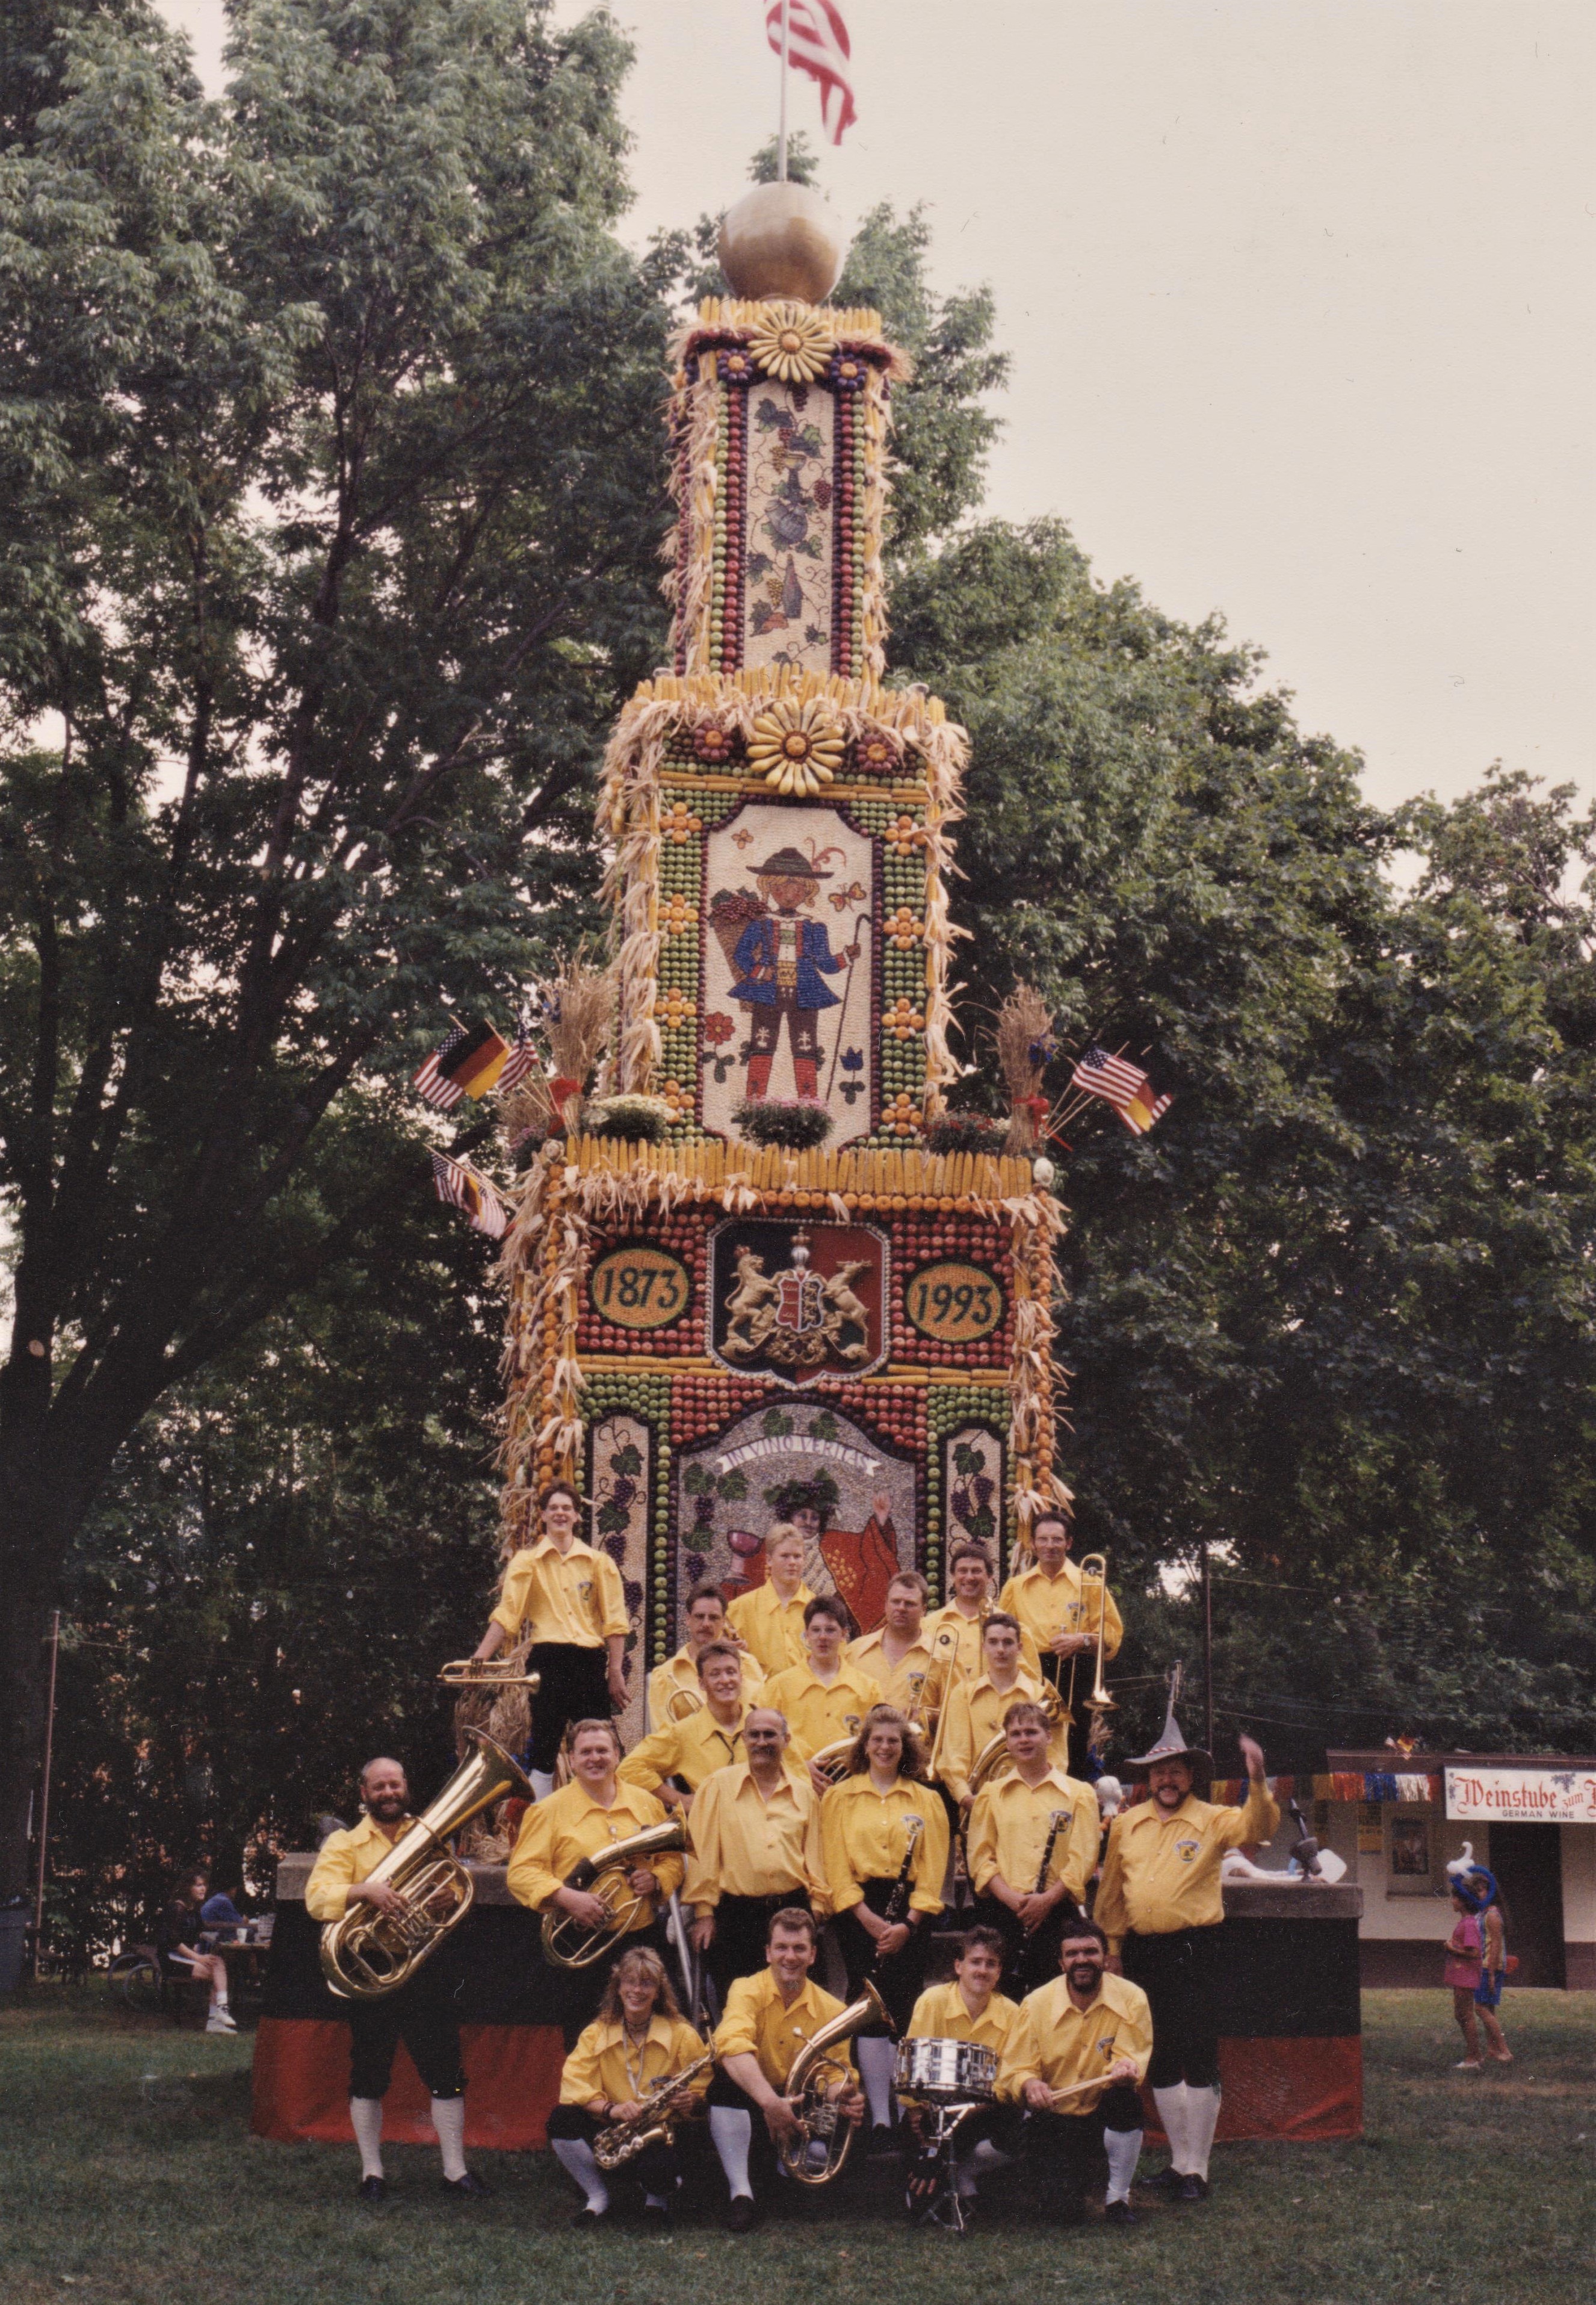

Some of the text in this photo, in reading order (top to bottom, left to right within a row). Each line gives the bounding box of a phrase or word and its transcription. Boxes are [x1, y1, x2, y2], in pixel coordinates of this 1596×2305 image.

[602, 1266, 679, 1308] 1873
[918, 1283, 992, 1324] 1993
[725, 1436, 868, 1472] IN VINO VERITAS
[1453, 1777, 1557, 1814] Weinstube
[1562, 1793, 1584, 1810] zum
[1502, 1810, 1542, 1818] GERMAN
